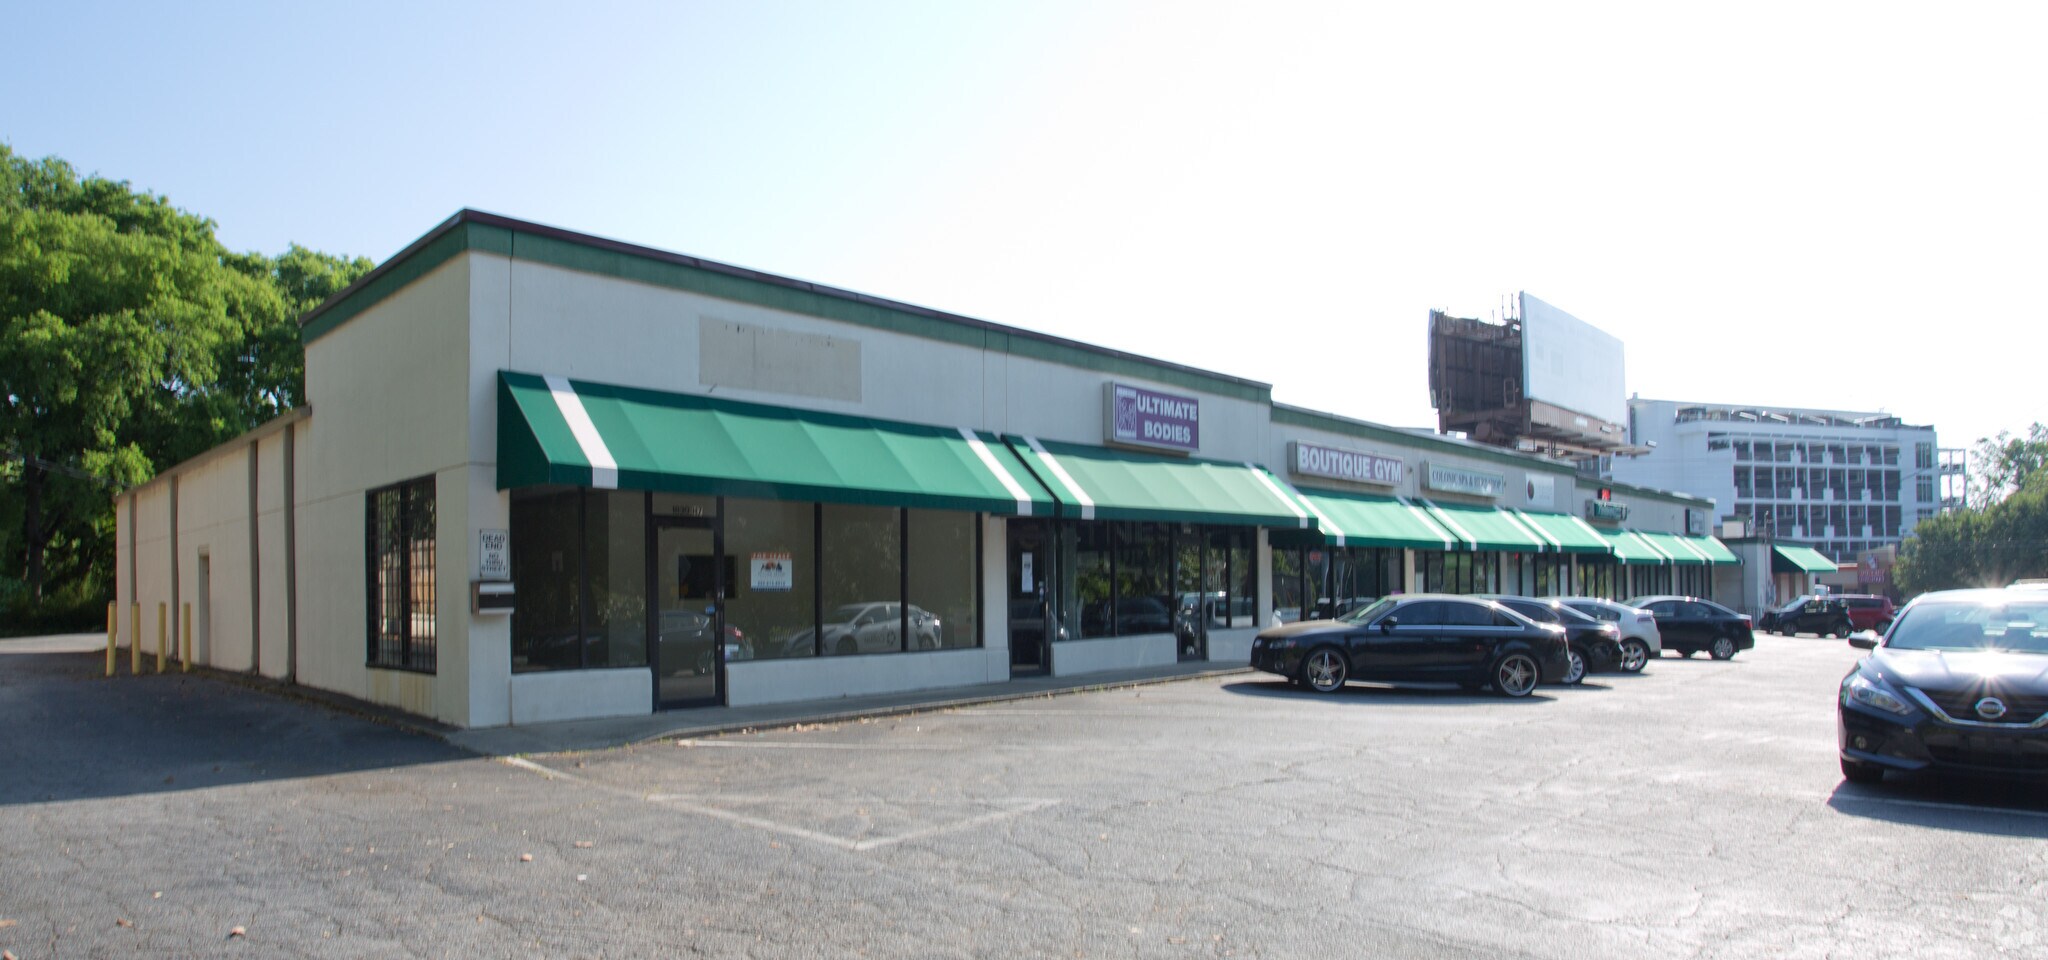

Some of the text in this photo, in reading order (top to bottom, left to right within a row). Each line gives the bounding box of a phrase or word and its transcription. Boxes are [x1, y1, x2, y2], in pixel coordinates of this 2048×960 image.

[1137, 394, 1197, 421] ULTIMATE
[1144, 420, 1191, 443] BODIES
[1299, 445, 1402, 482] BOUTIQUE GYM
[1432, 468, 1458, 483] COLONIC
[482, 533, 505, 543] DEAD
[486, 541, 503, 550] END
[481, 565, 506, 573] STREET
